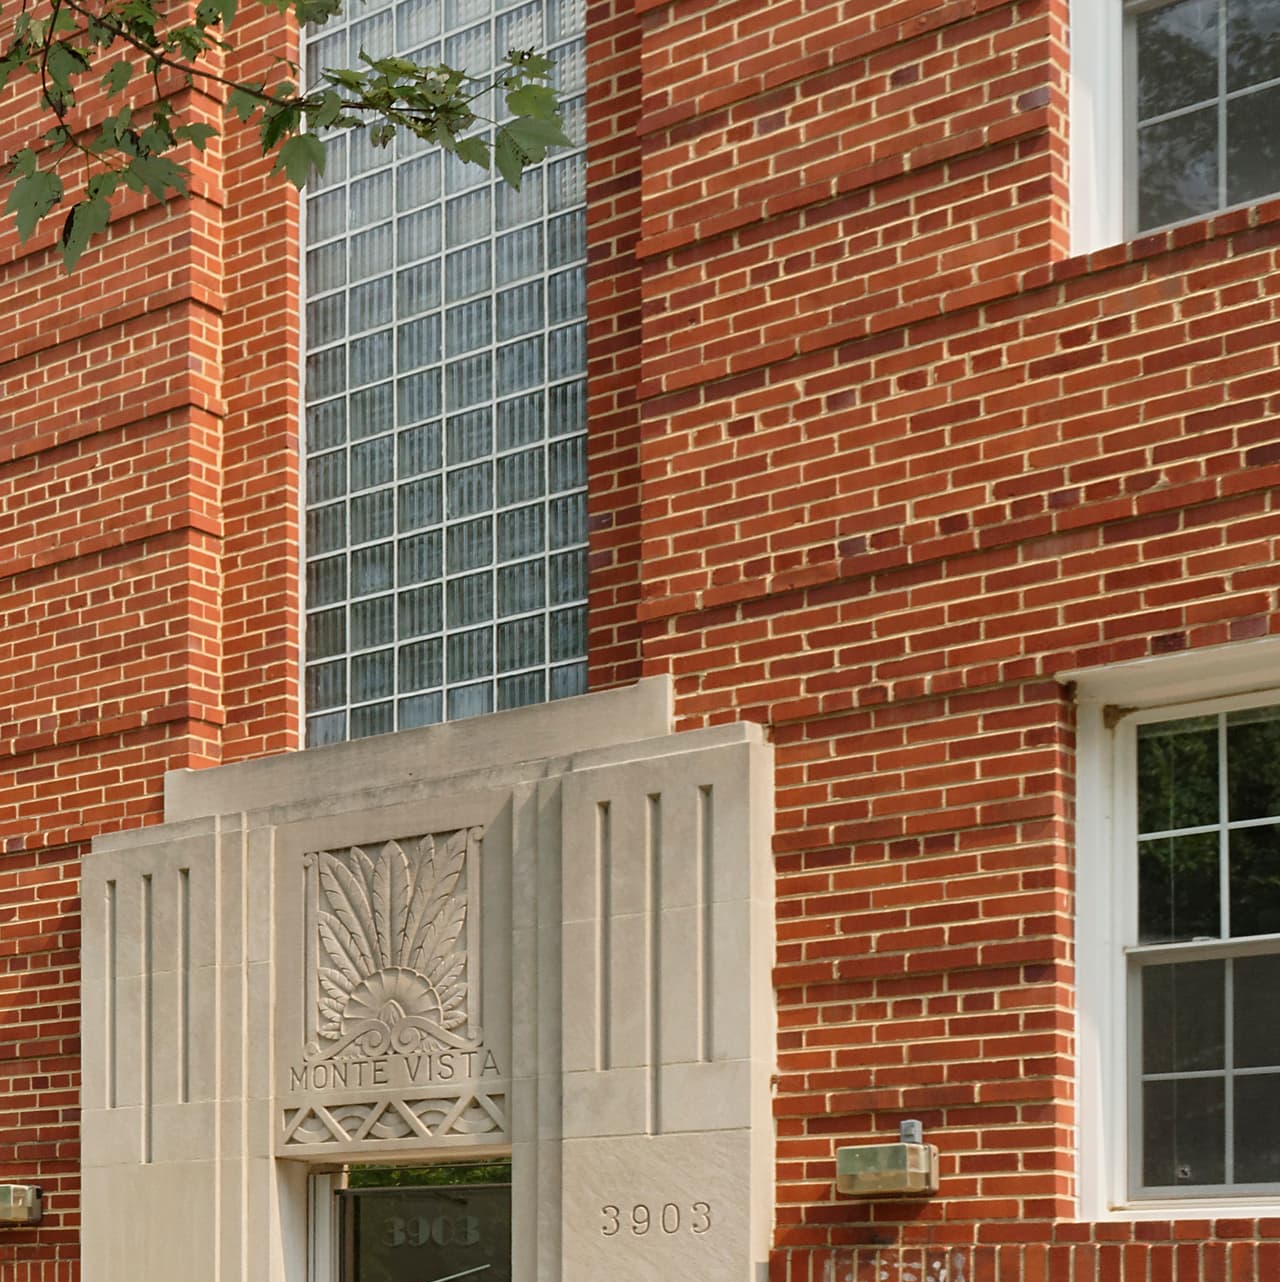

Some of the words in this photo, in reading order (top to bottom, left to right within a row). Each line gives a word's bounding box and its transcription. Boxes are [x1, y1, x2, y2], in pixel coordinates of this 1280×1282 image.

[290, 1059, 388, 1091] MONTE
[404, 1049, 501, 1083] VISTA
[382, 1215, 481, 1247] 3903
[602, 1201, 711, 1236] 3903
